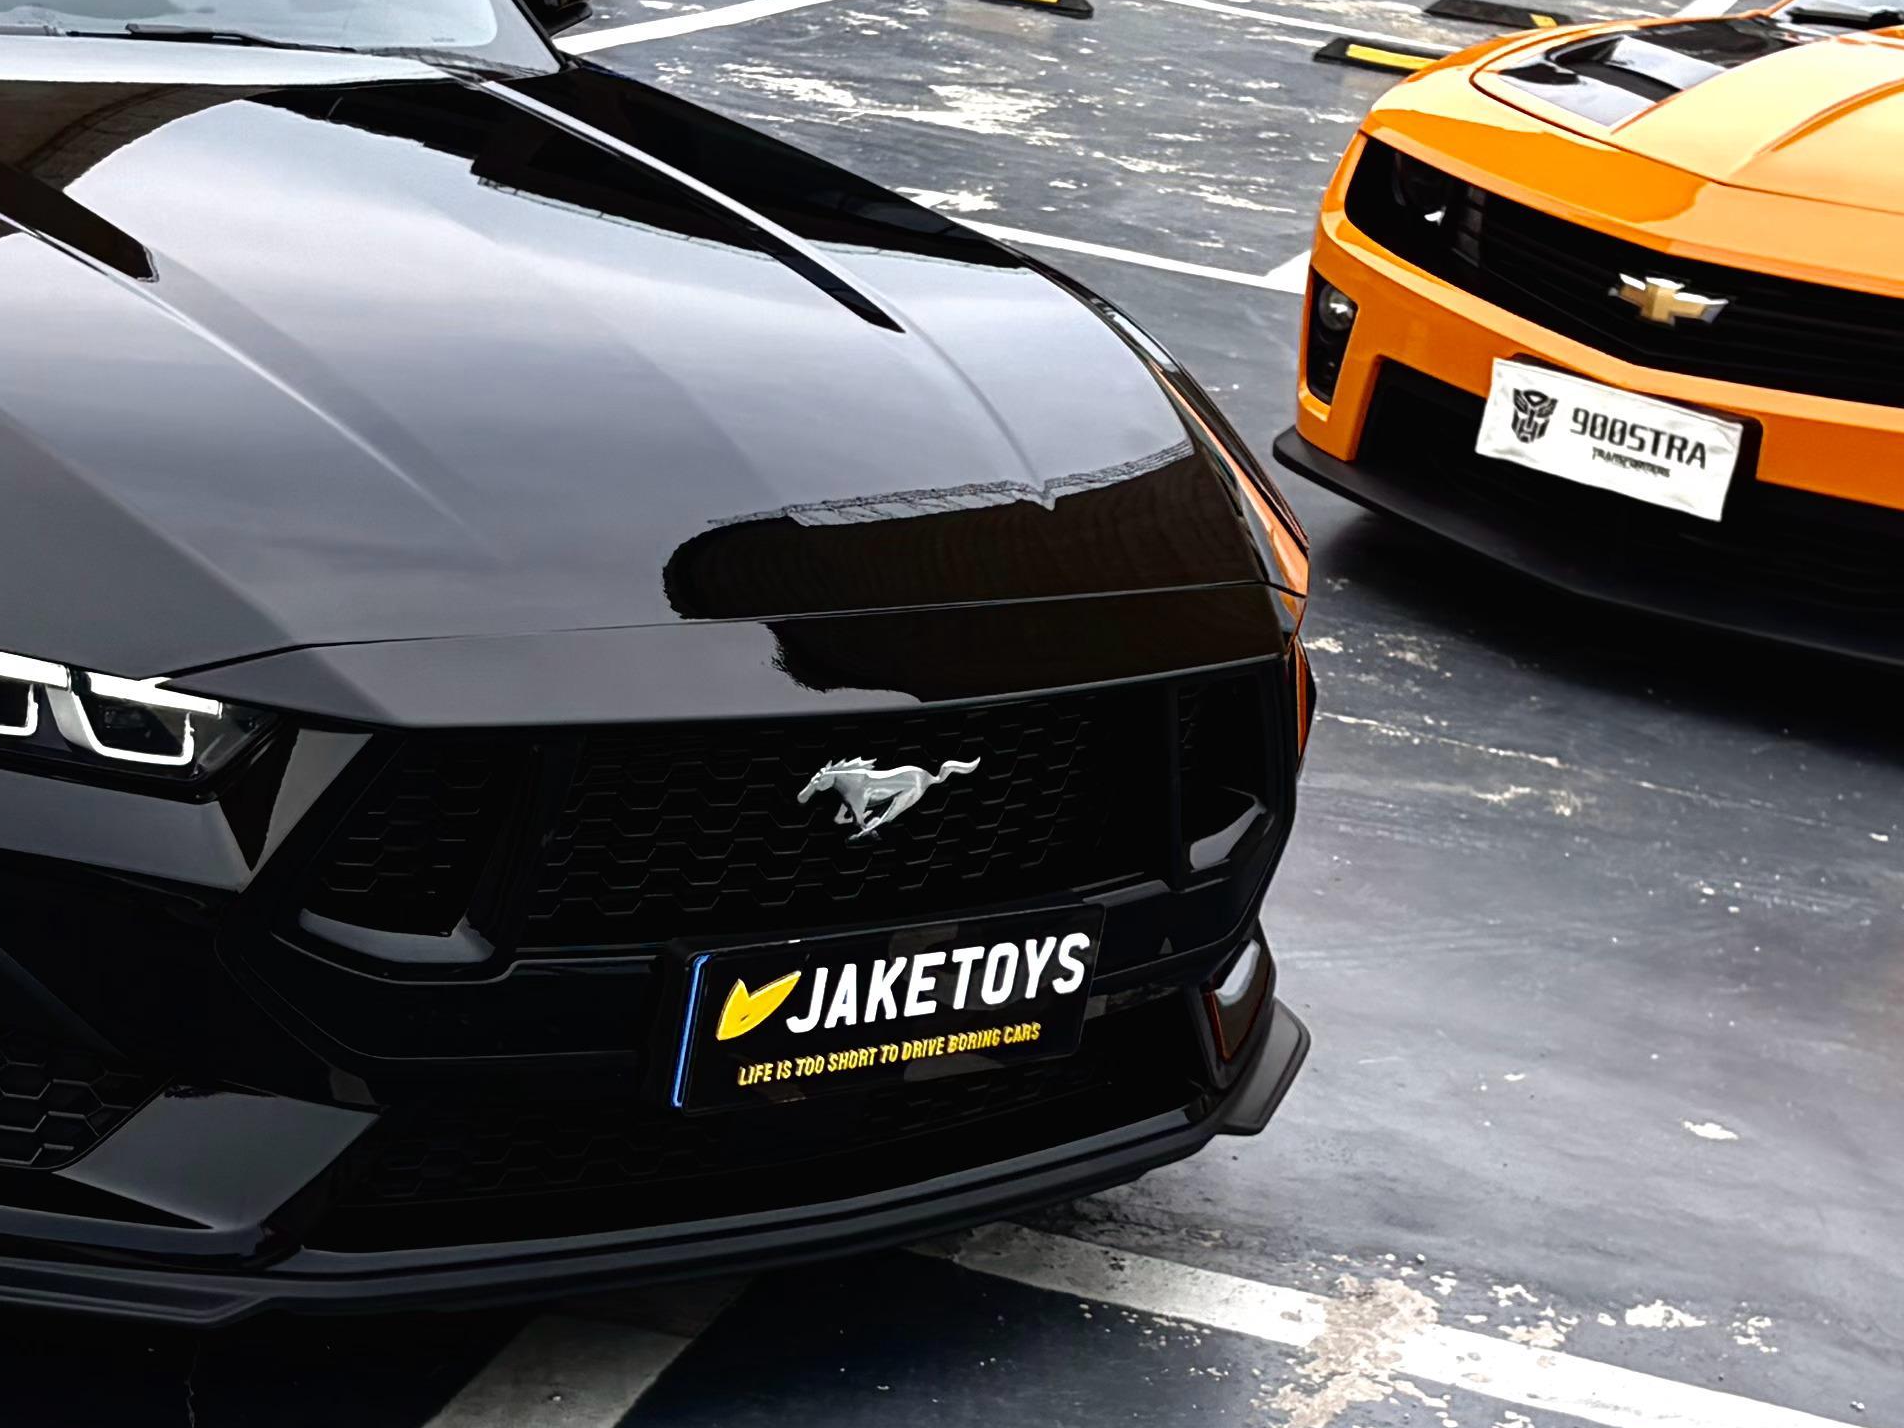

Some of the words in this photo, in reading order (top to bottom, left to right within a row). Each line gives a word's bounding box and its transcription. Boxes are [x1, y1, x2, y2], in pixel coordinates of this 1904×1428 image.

[785, 932, 1091, 1034] JAKETOYS
[737, 1061, 773, 1086] LIFE
[776, 1059, 792, 1079] IS
[795, 1055, 825, 1077] TOO
[828, 1047, 878, 1073] SHORT
[880, 1044, 899, 1063] TO
[901, 1037, 946, 1061] DRIVE
[948, 1028, 1001, 1053] BORING
[1004, 1022, 1041, 1044] CARS
